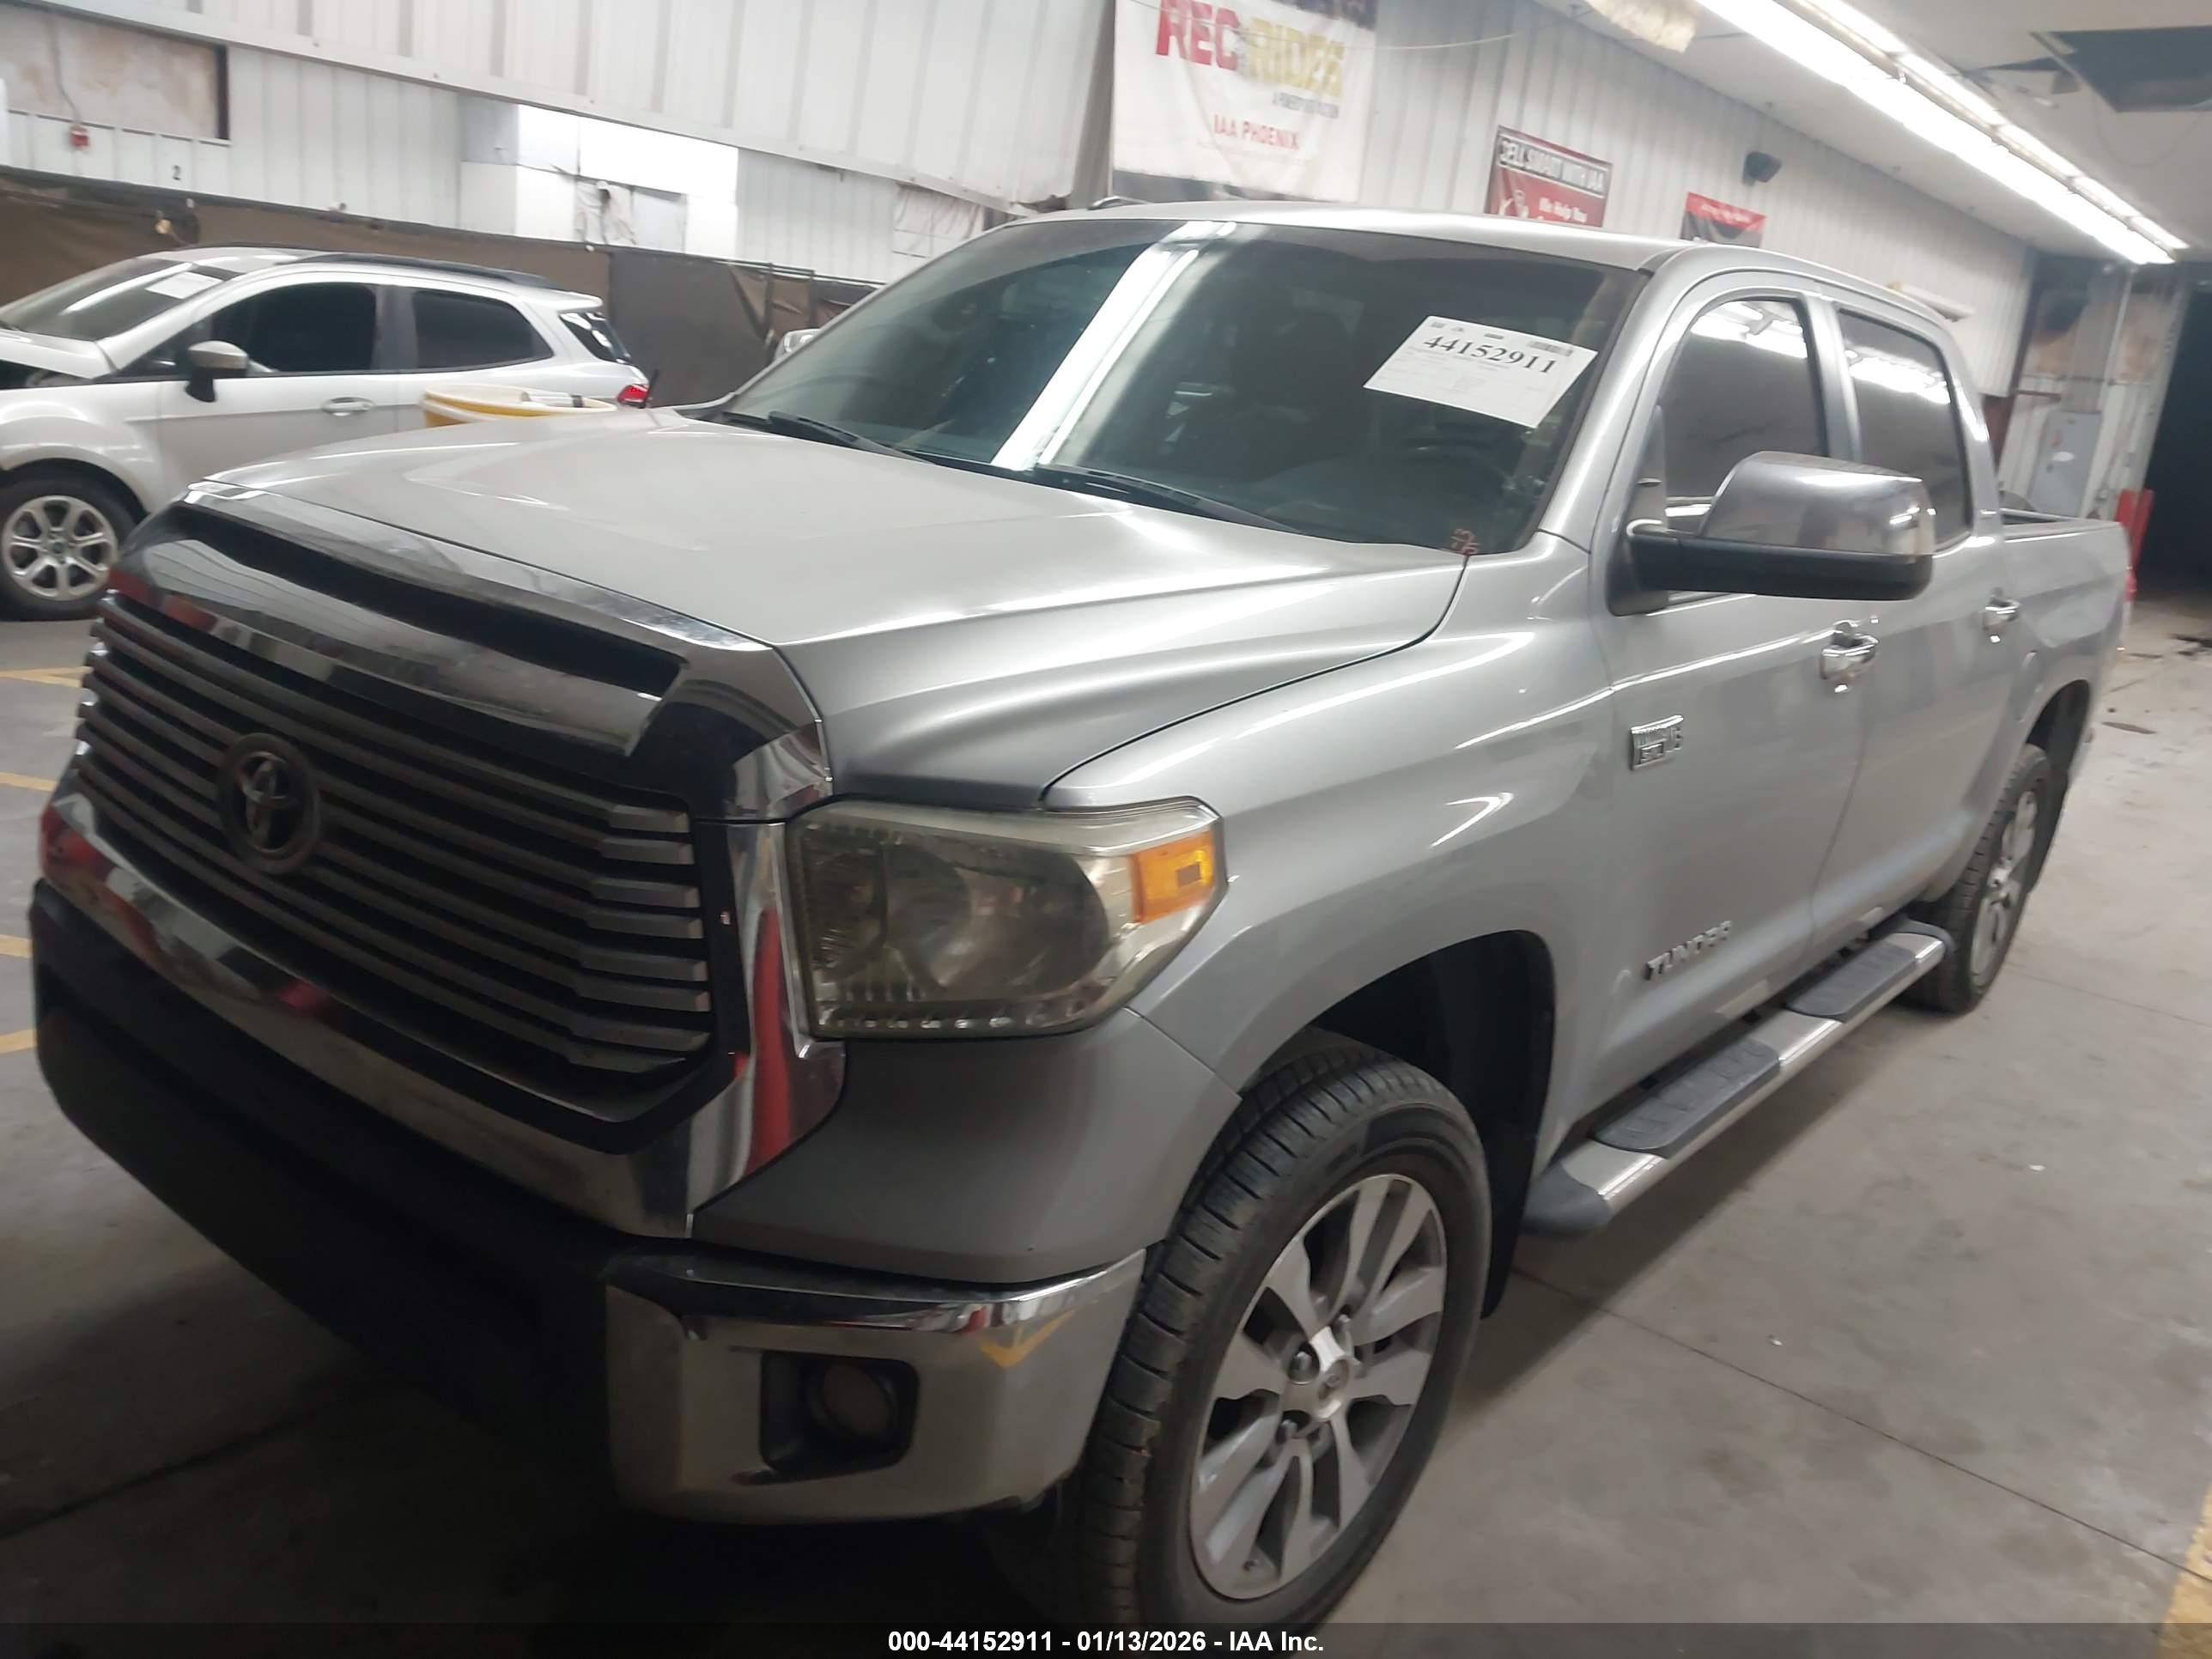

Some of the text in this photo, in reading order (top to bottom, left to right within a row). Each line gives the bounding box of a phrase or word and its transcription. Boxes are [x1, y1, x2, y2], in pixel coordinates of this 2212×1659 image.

[1242, 120, 1299, 150] PHOENIX
[171, 164, 182, 181] 2
[1424, 335, 1557, 374] 44152911
